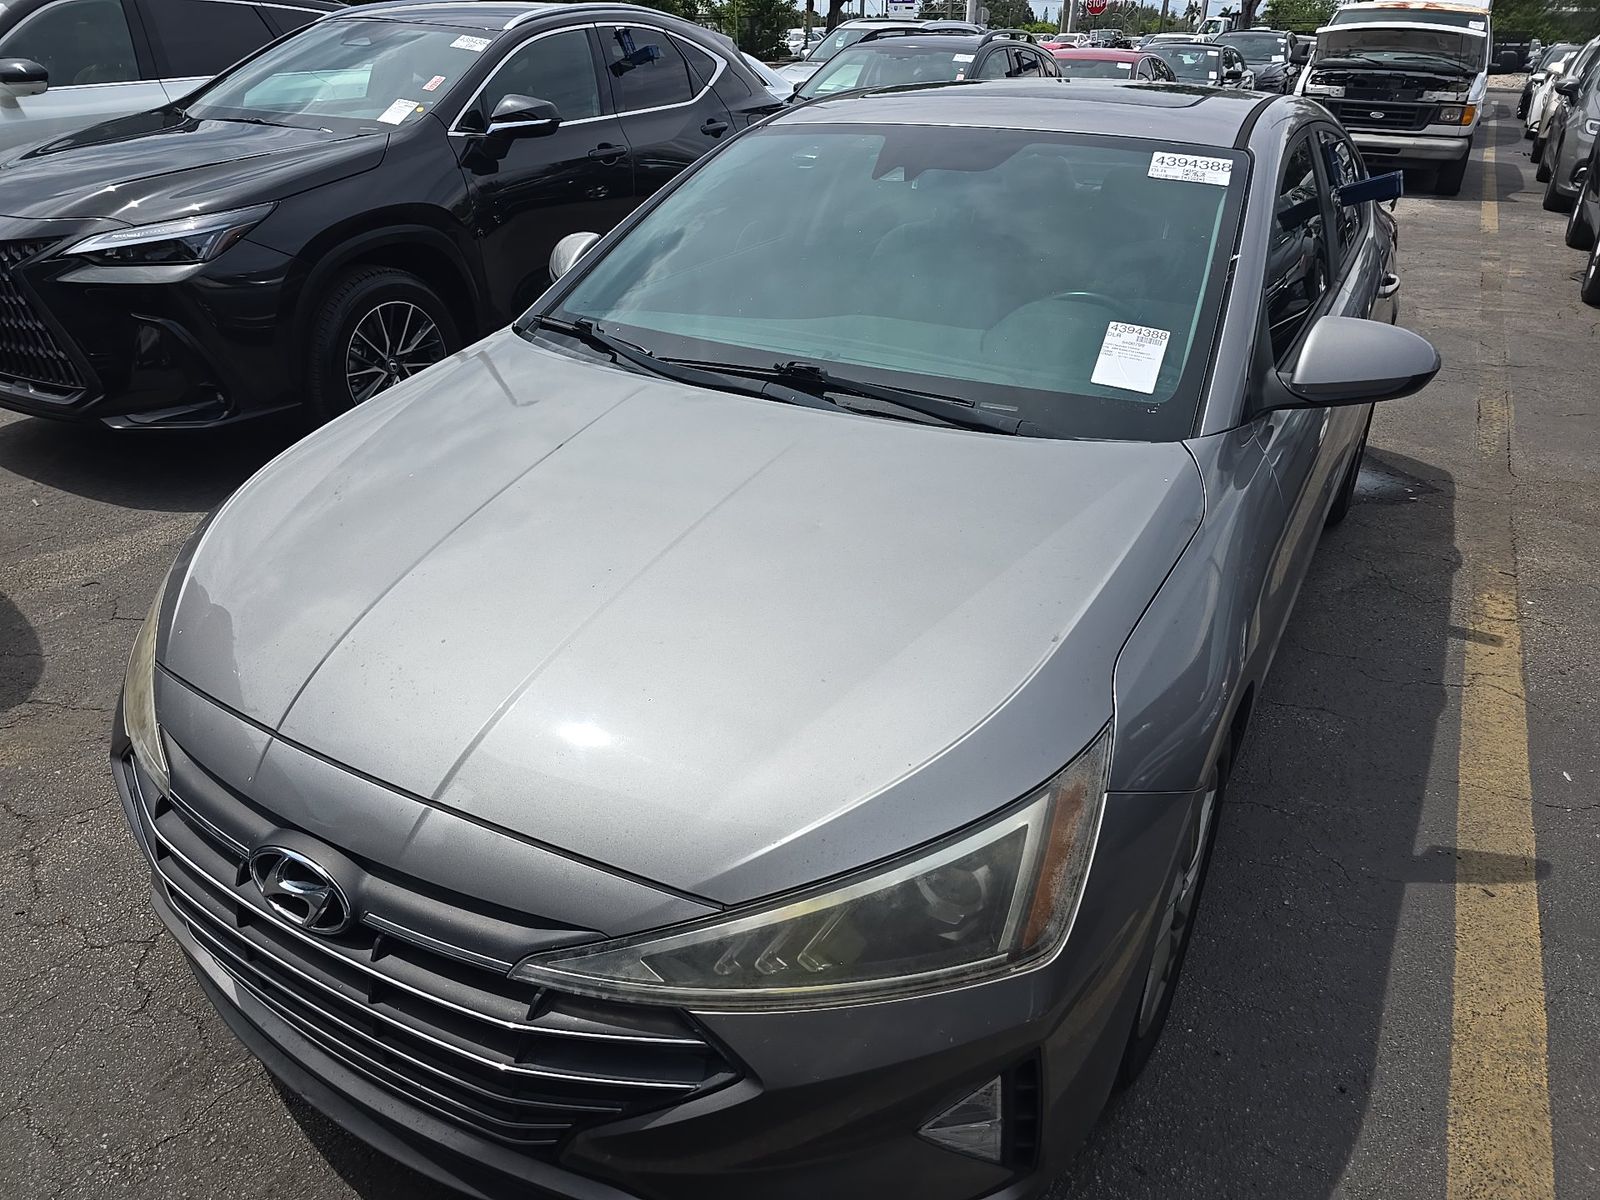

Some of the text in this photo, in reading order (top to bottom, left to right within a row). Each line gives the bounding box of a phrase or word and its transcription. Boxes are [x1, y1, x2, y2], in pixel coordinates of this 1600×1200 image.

[1088, 0, 1105, 8] STOP
[1155, 156, 1232, 173] 4394388
[1111, 324, 1168, 341] 4394388
